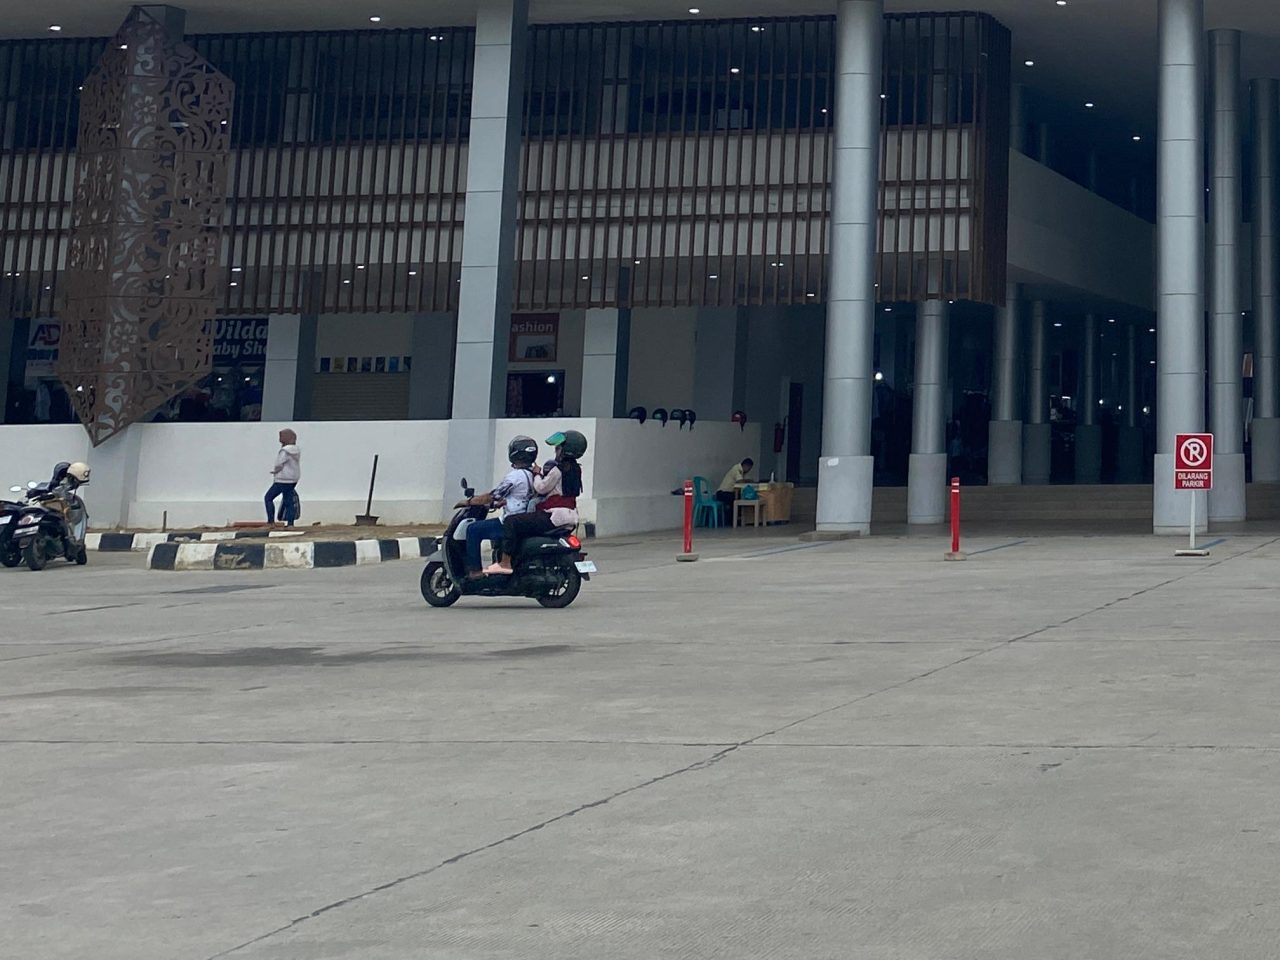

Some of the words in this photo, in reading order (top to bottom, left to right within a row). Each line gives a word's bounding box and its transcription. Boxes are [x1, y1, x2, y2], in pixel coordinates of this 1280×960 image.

[511, 321, 553, 333] ashion
[212, 341, 241, 358] aby
[1177, 472, 1209, 480] DILARANG
[1182, 480, 1204, 488] PARKIR
